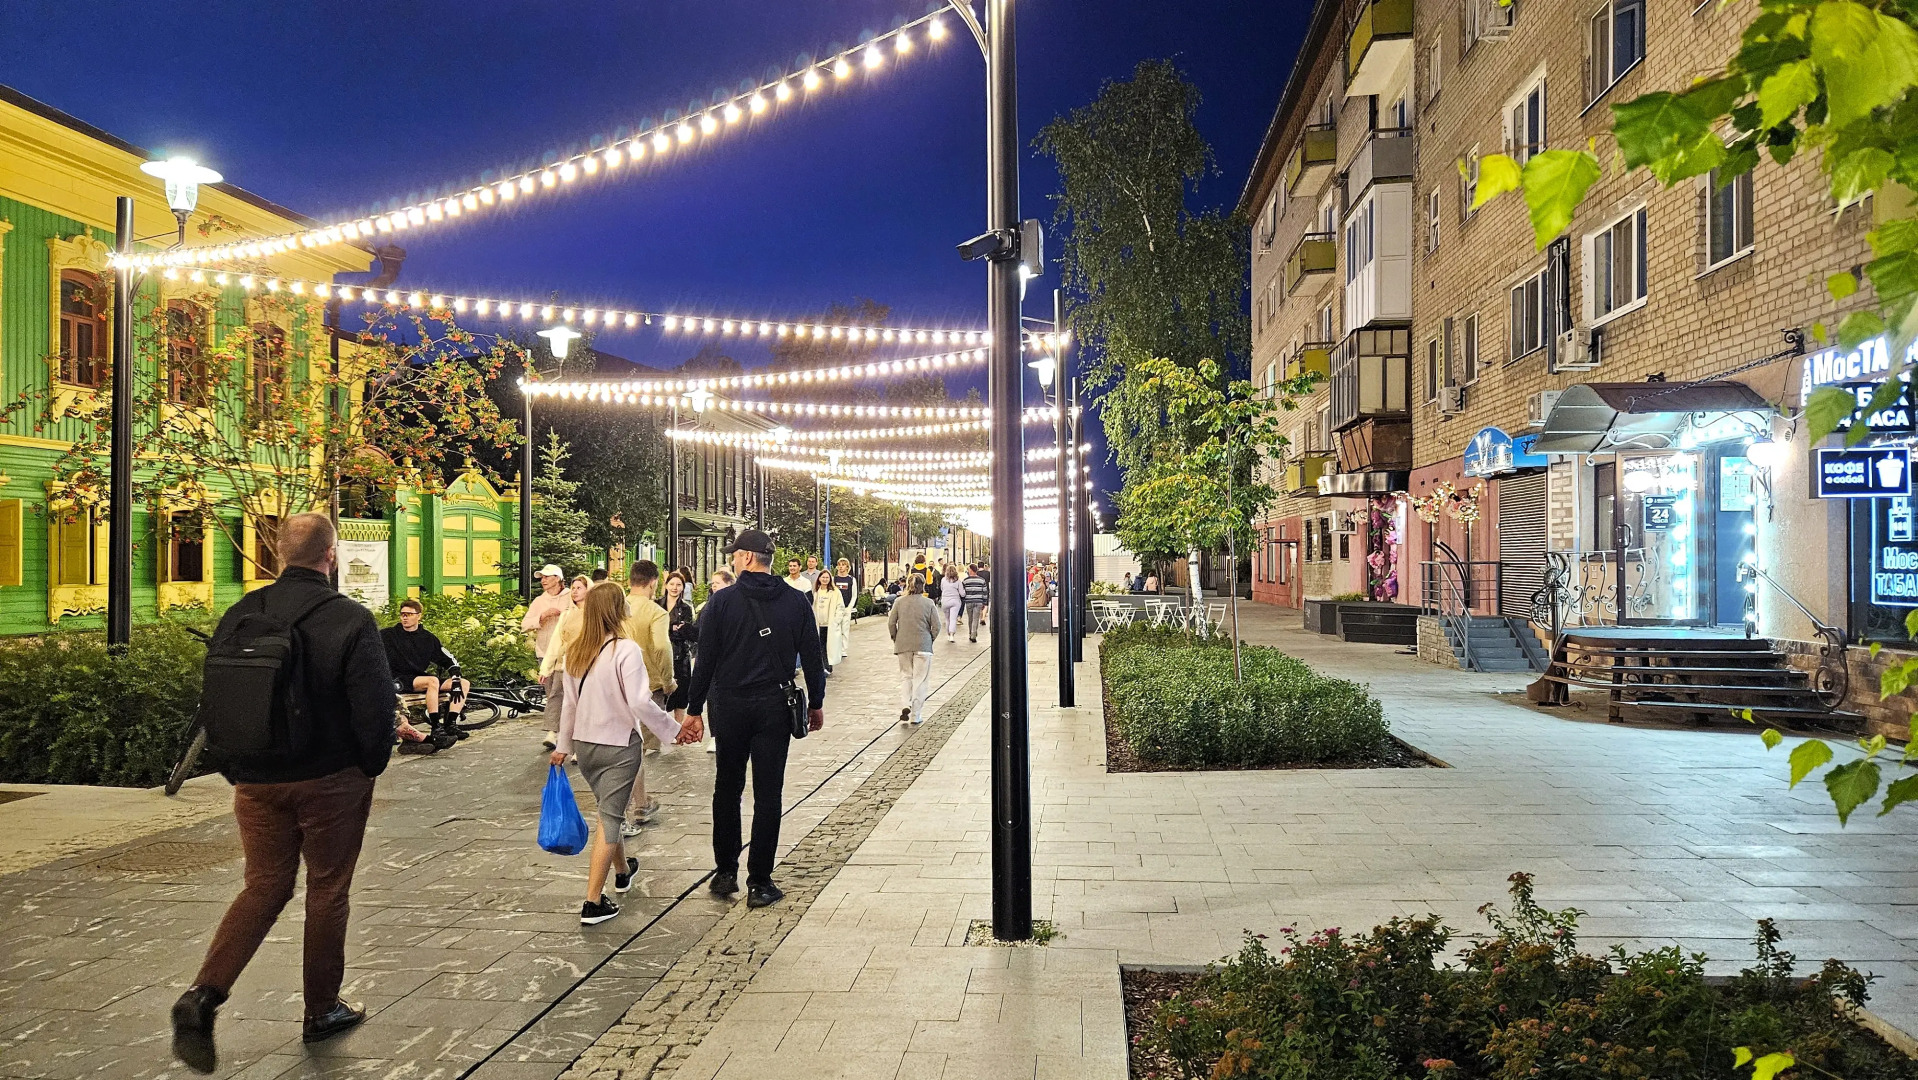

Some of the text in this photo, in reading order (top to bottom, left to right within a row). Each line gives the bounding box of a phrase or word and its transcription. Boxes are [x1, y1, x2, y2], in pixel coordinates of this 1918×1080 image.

[1825, 461, 1864, 474] КОФЕ
[1652, 508, 1669, 519] 24
[1875, 573, 1918, 597] ТАБА
